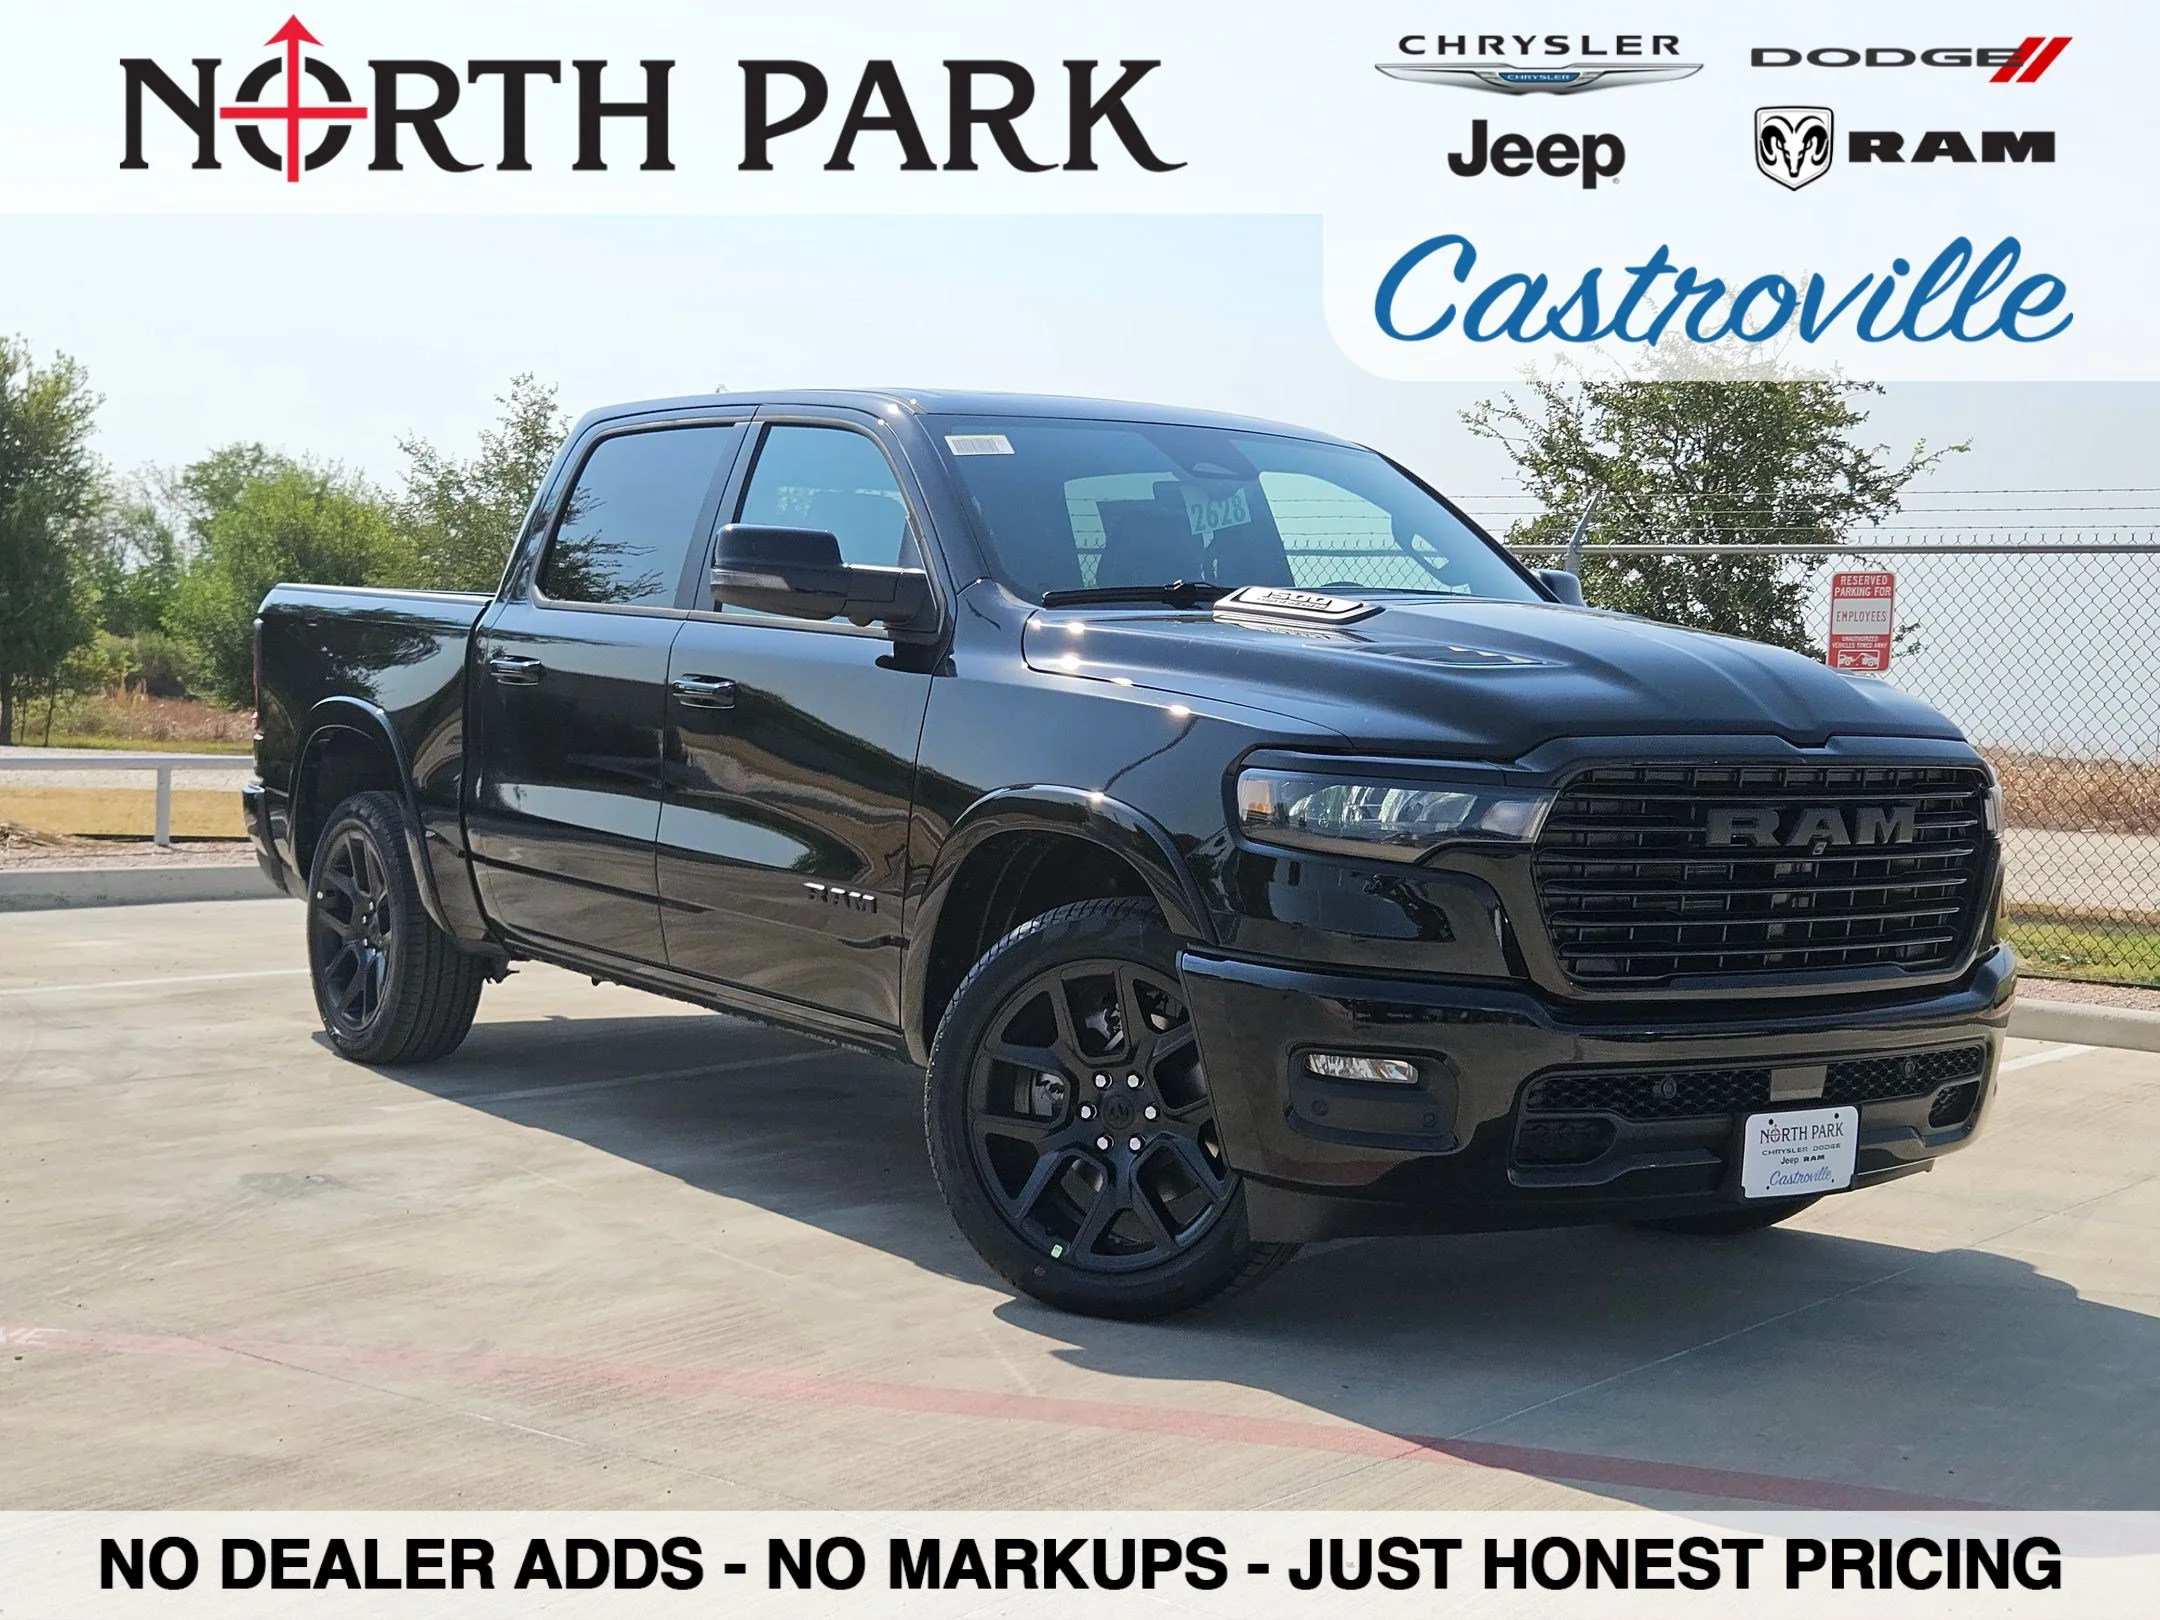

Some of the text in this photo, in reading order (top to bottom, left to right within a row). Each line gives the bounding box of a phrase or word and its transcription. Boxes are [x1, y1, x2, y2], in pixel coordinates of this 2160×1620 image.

[1190, 496, 1246, 531] 2628
[1840, 575, 1888, 586] RESERVED
[1834, 586, 1892, 597] PARKING FOR
[1836, 610, 1887, 622] EMPLOYEES
[1704, 806, 1916, 847] RAM
[1760, 1122, 1844, 1144] NORTH PARK
[1761, 1143, 1841, 1156] CHRYSLER DODGE
[1780, 1154, 1825, 1165] Jeep RAM
[1769, 1166, 1832, 1186] Castroville
